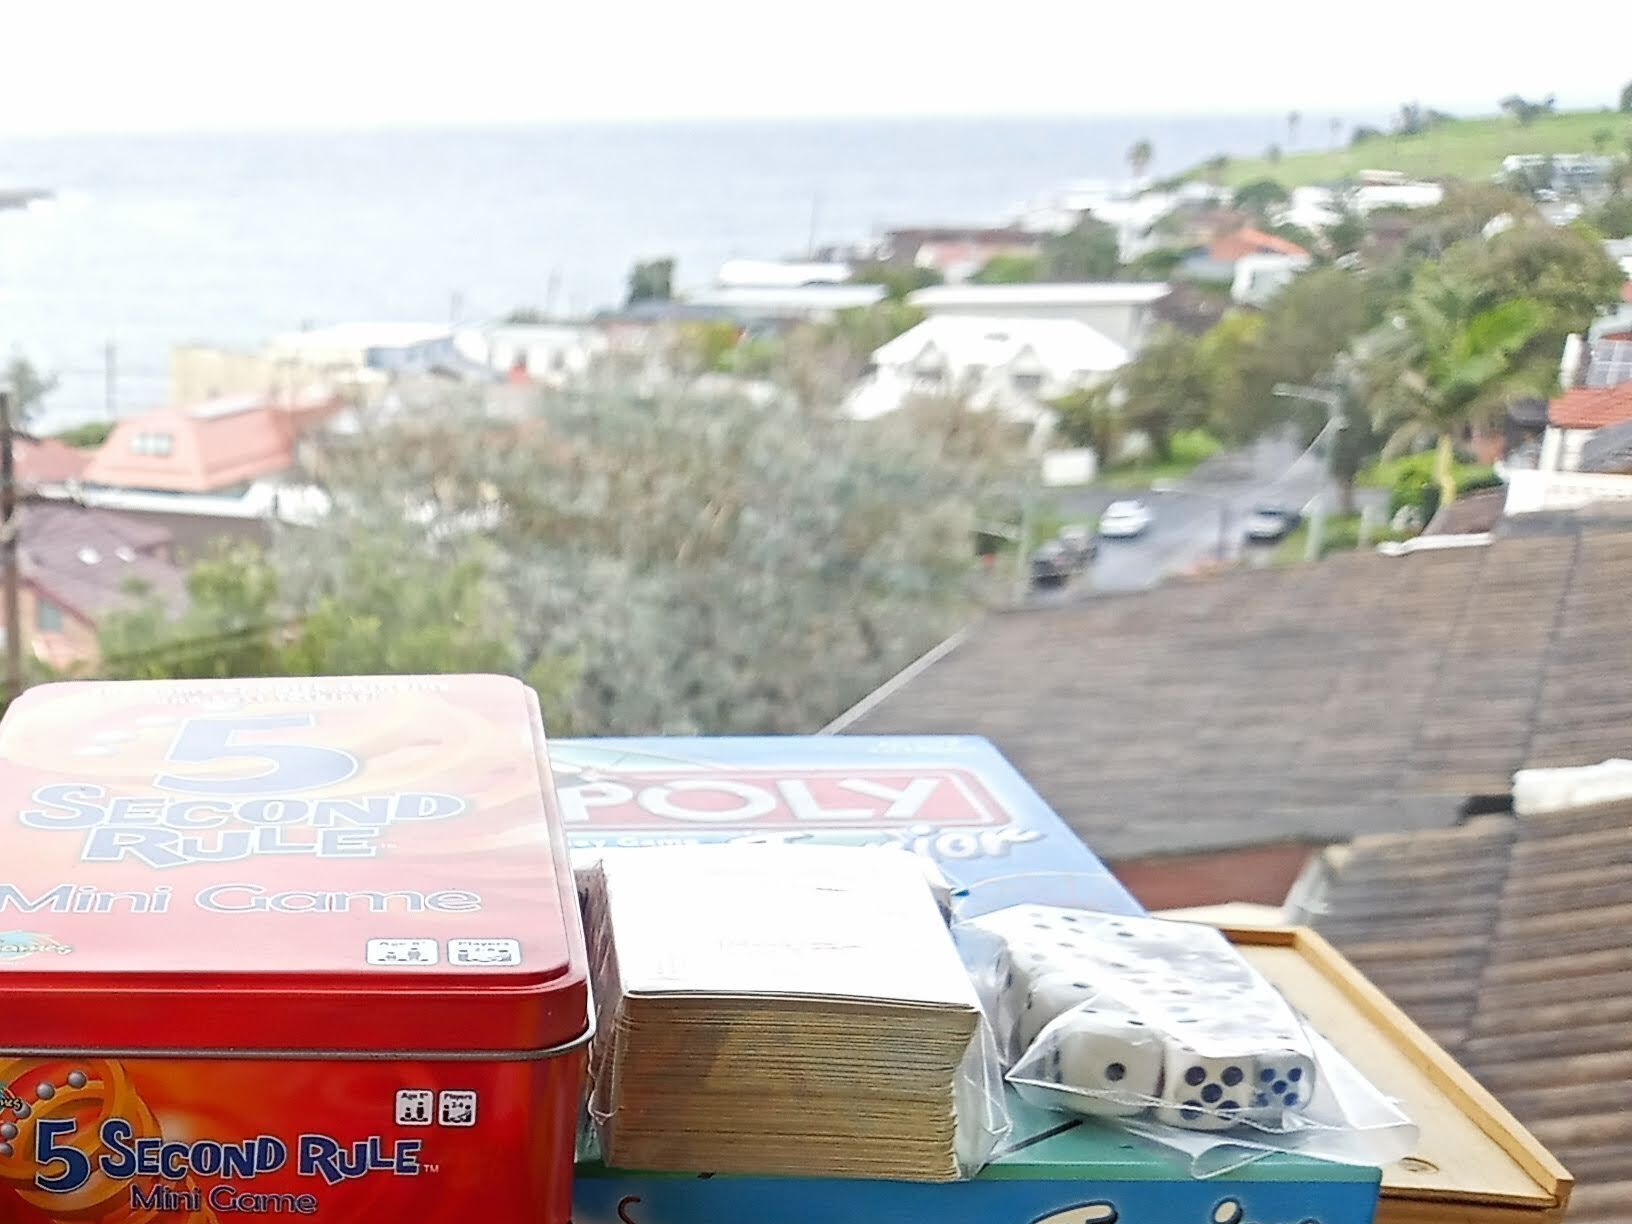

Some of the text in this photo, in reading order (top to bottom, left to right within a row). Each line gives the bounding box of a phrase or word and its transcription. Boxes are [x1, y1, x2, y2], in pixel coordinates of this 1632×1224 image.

[152, 714, 357, 794] 5
[20, 785, 466, 830] SECOND
[563, 778, 942, 822] POLY
[80, 824, 378, 868] RULE
[194, 884, 482, 914] Game
[33, 1117, 422, 1194] 5 SECOND RULE
[129, 1184, 317, 1213] Mini Game
